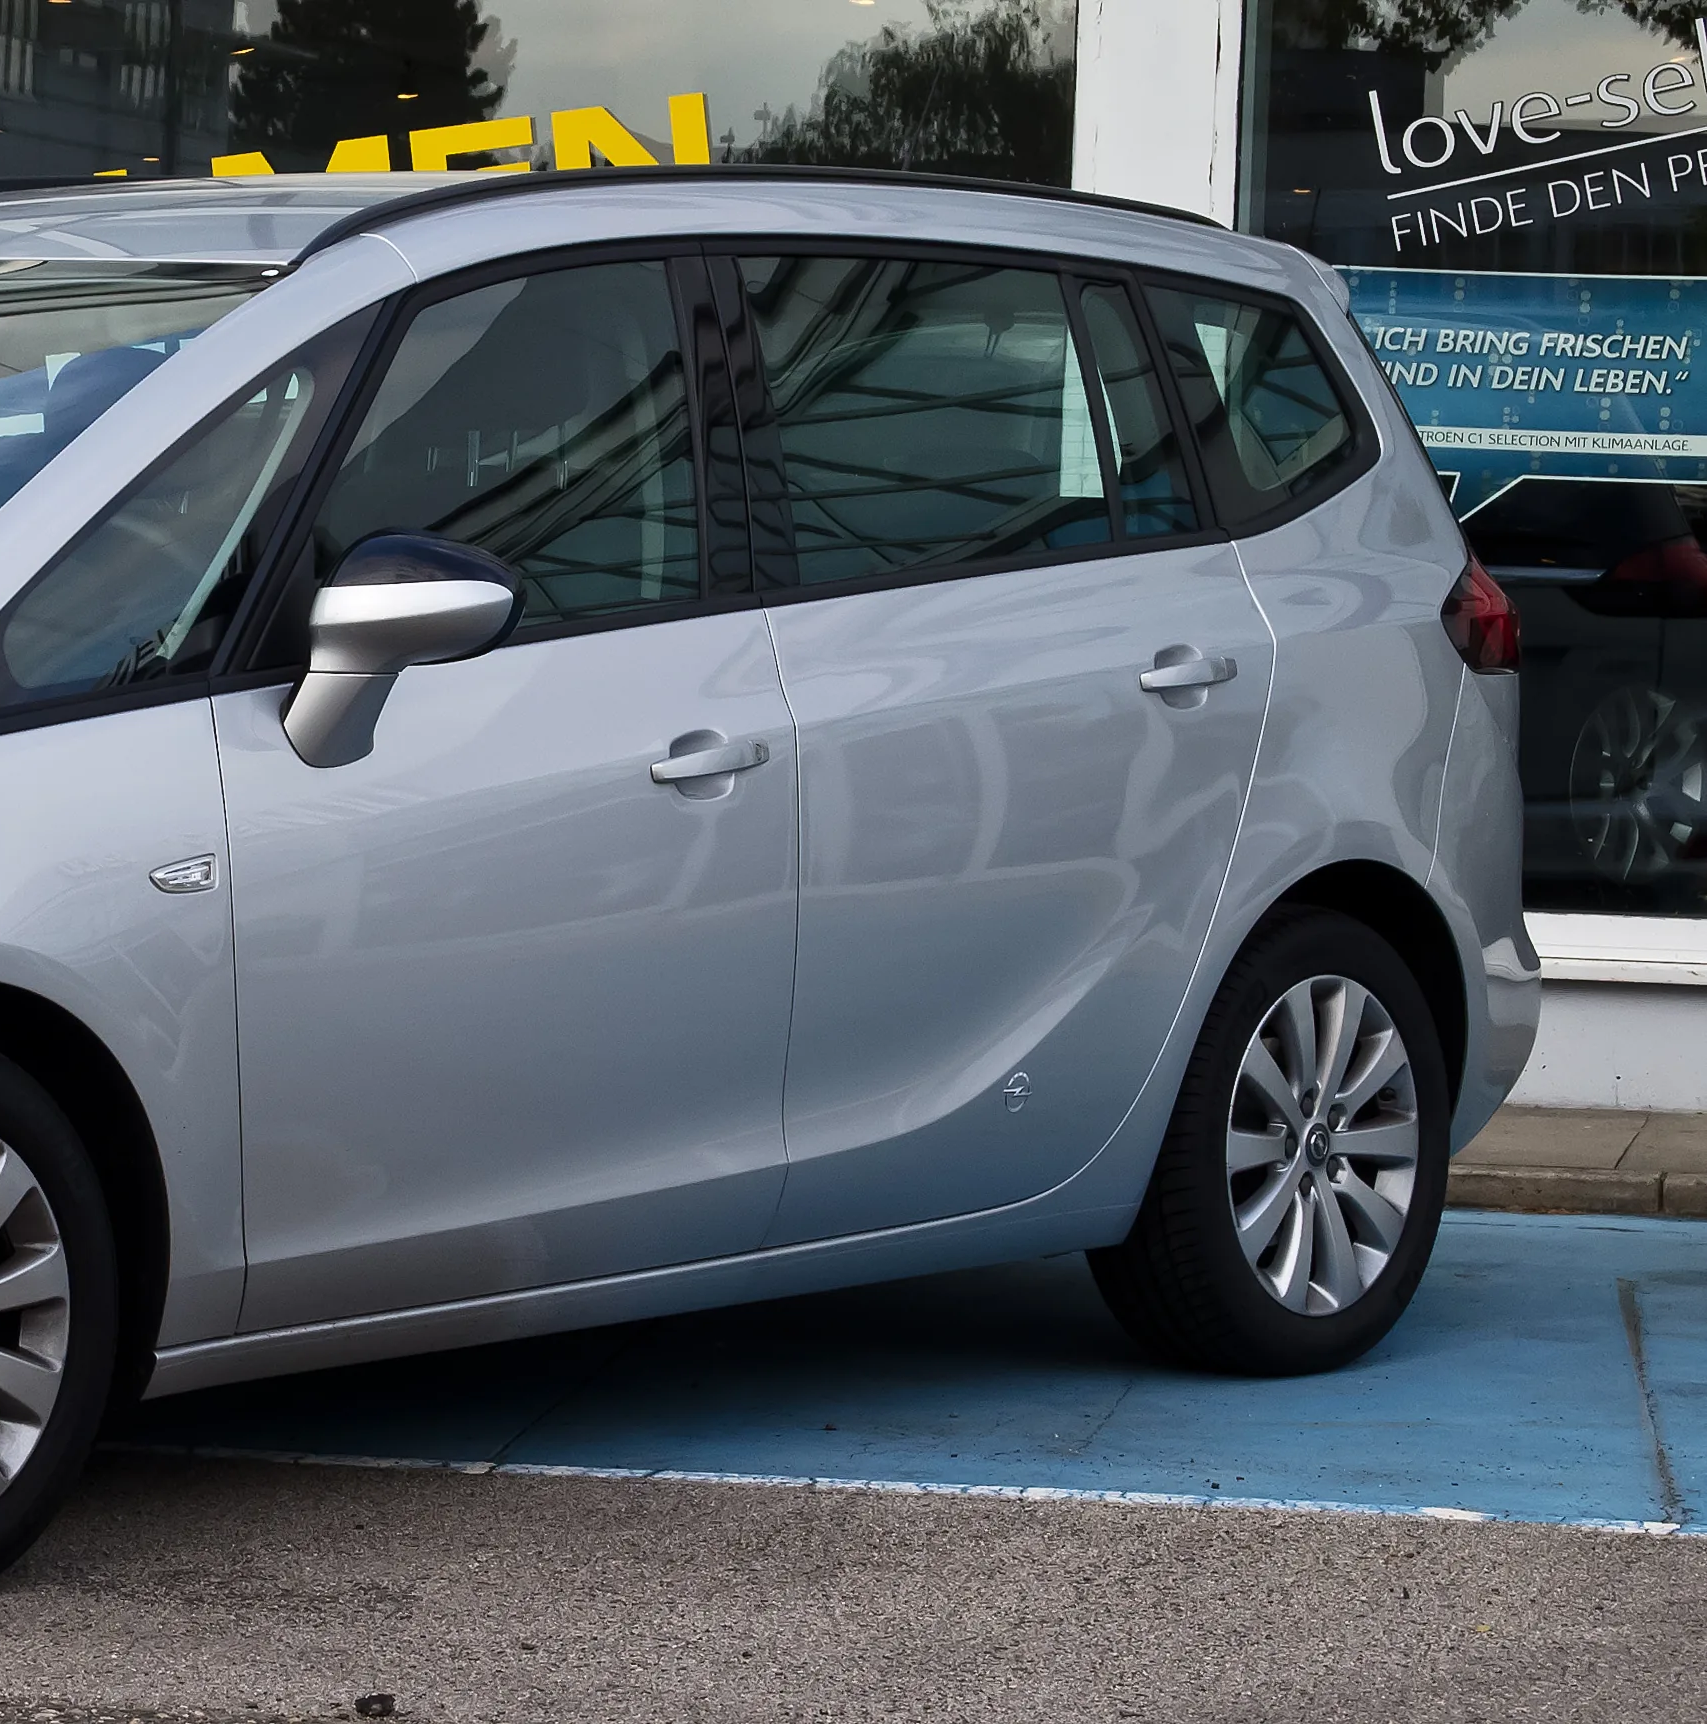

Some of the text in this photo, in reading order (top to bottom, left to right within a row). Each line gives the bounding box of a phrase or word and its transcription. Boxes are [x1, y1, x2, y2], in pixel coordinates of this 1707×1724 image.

[1391, 187, 1534, 252] FINDE
[1547, 162, 1652, 218] DEN
[1375, 326, 1688, 360] ICH BRING FRISCHEN
[1380, 361, 1439, 386] IND
[1447, 363, 1482, 388] IN
[1491, 365, 1565, 391] DEIN
[1467, 432, 1483, 444] C1
[1488, 433, 1561, 448] SELECTION
[1564, 436, 1589, 449] MIT
[1592, 437, 1693, 452] KLIMAANLAGE.
